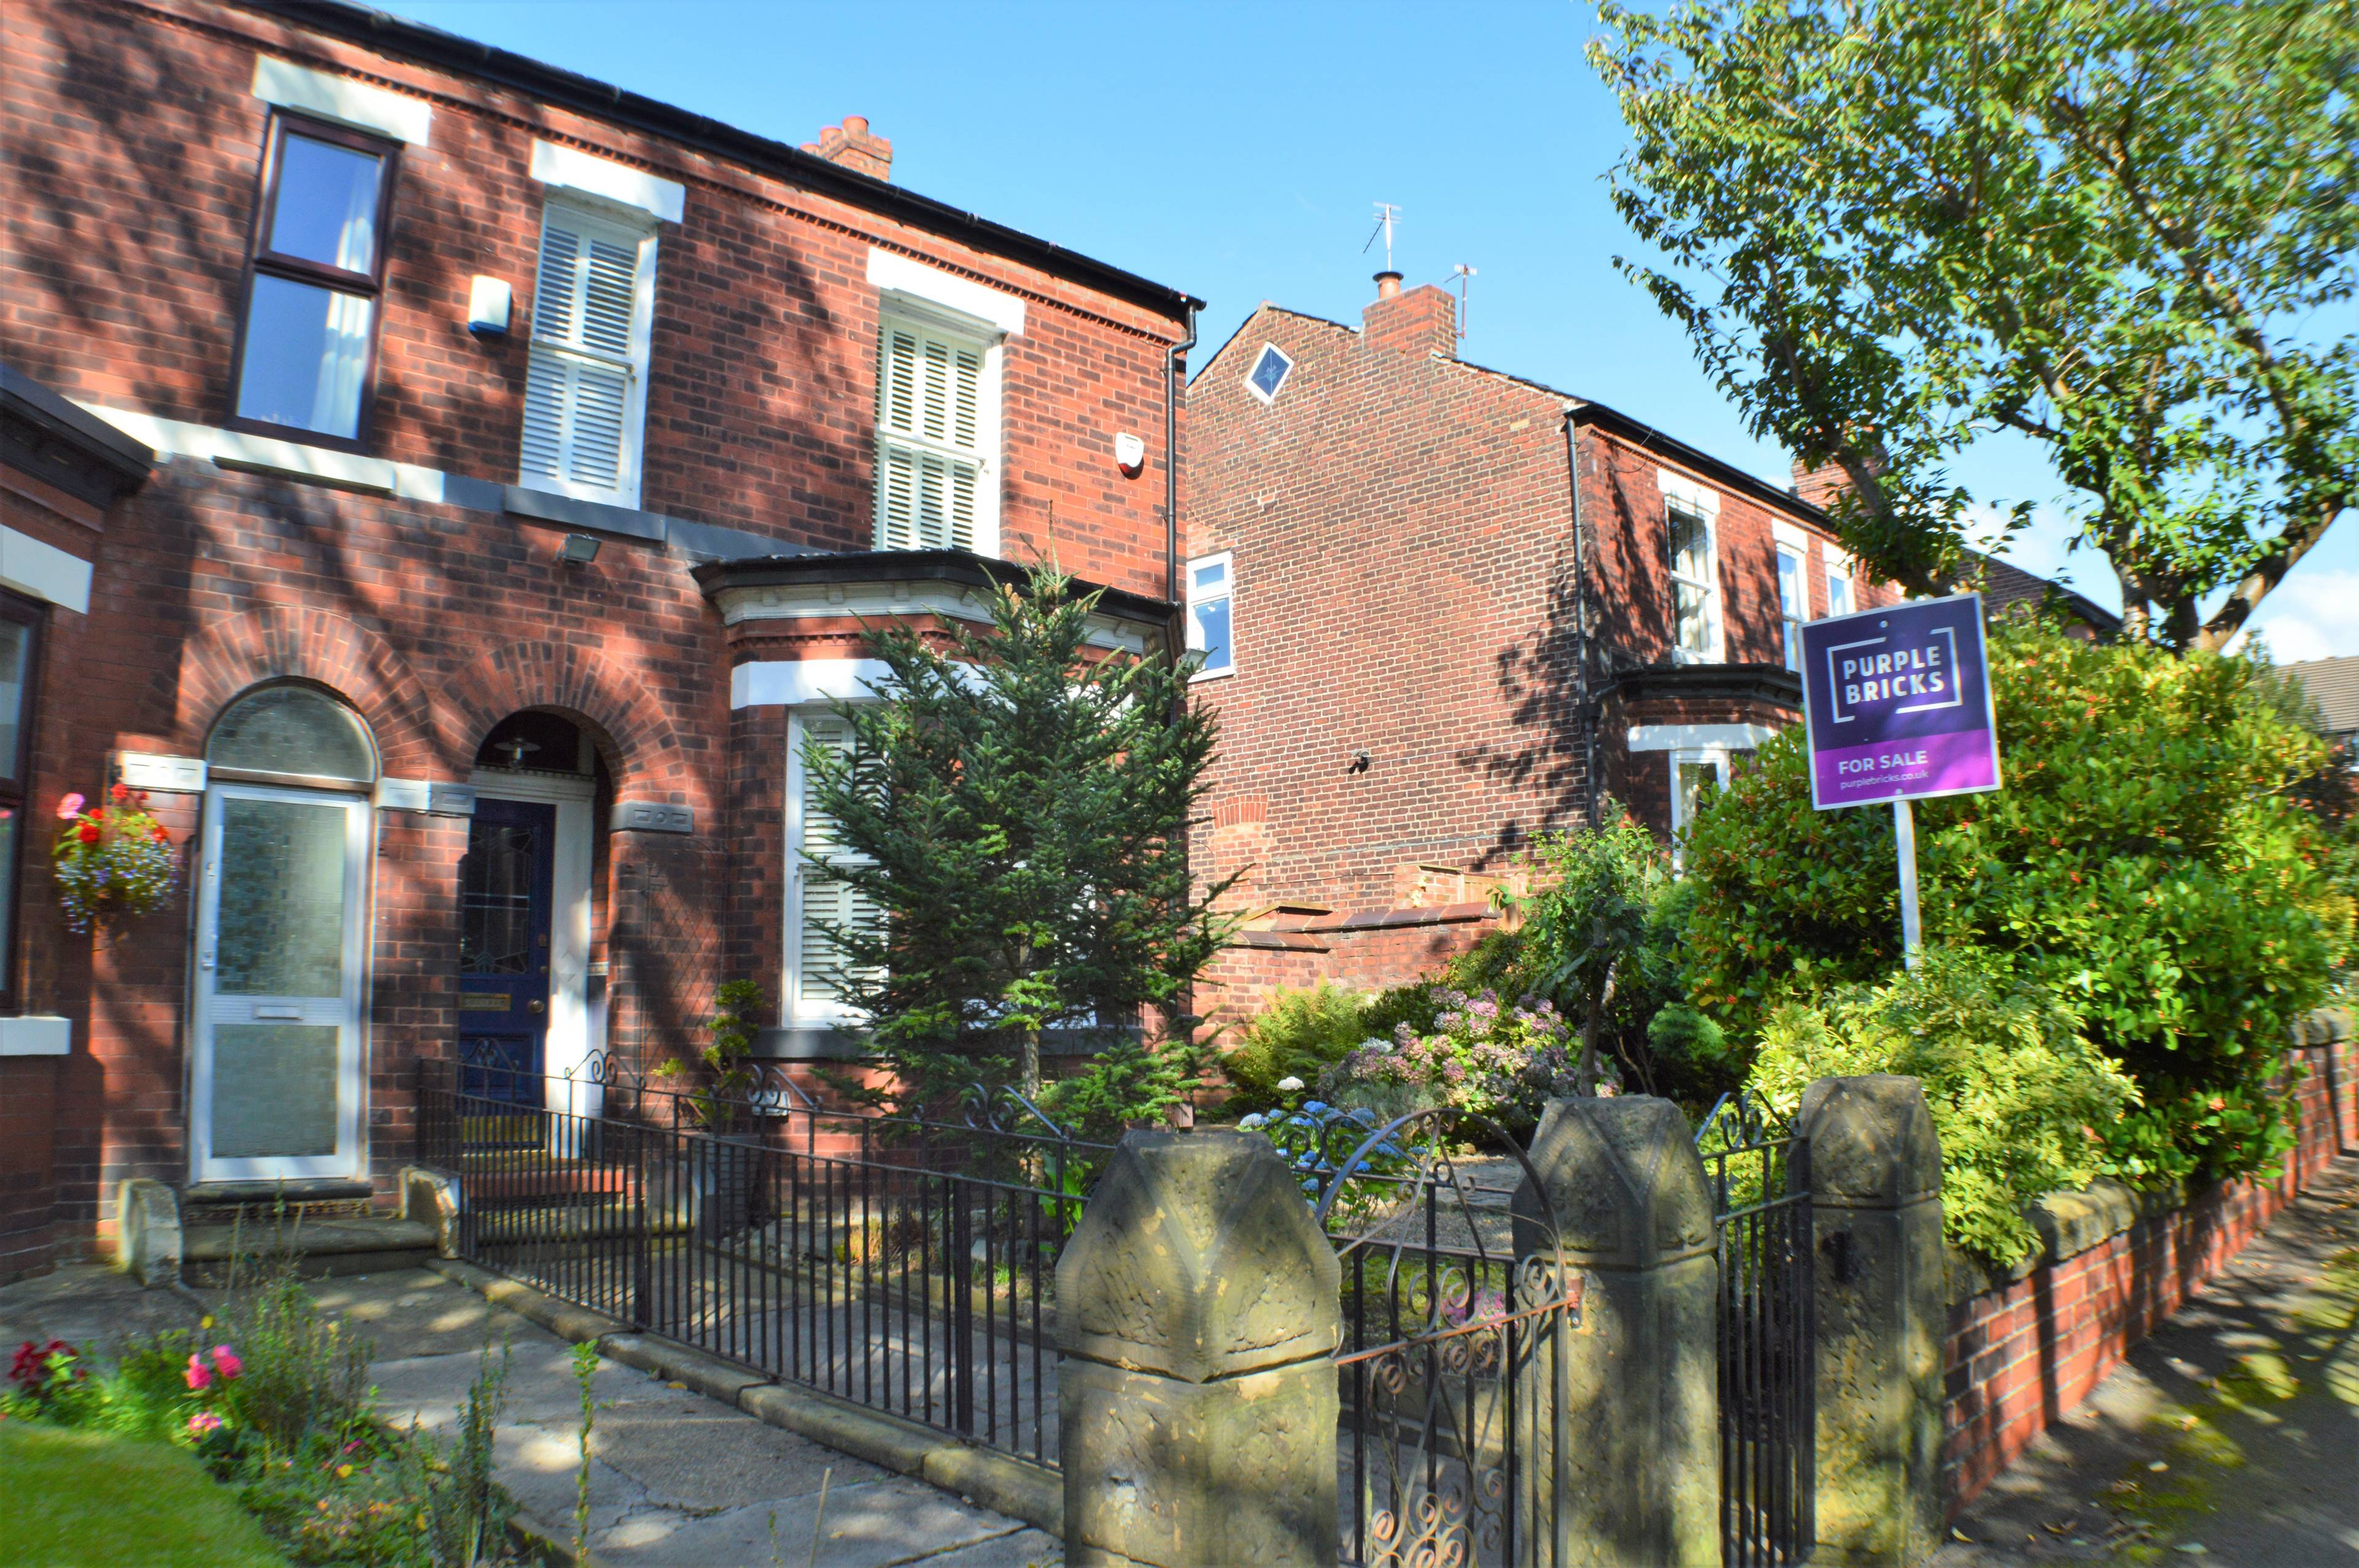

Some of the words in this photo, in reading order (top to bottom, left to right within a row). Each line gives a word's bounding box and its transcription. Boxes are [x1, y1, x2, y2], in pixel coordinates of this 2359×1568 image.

[1843, 646, 1941, 680] PURPLE
[1845, 671, 1944, 704] BRICKS
[1839, 757, 1875, 774] FOR
[1879, 750, 1928, 768] SALE
[1840, 770, 1928, 790] purplebricks.co.uk
